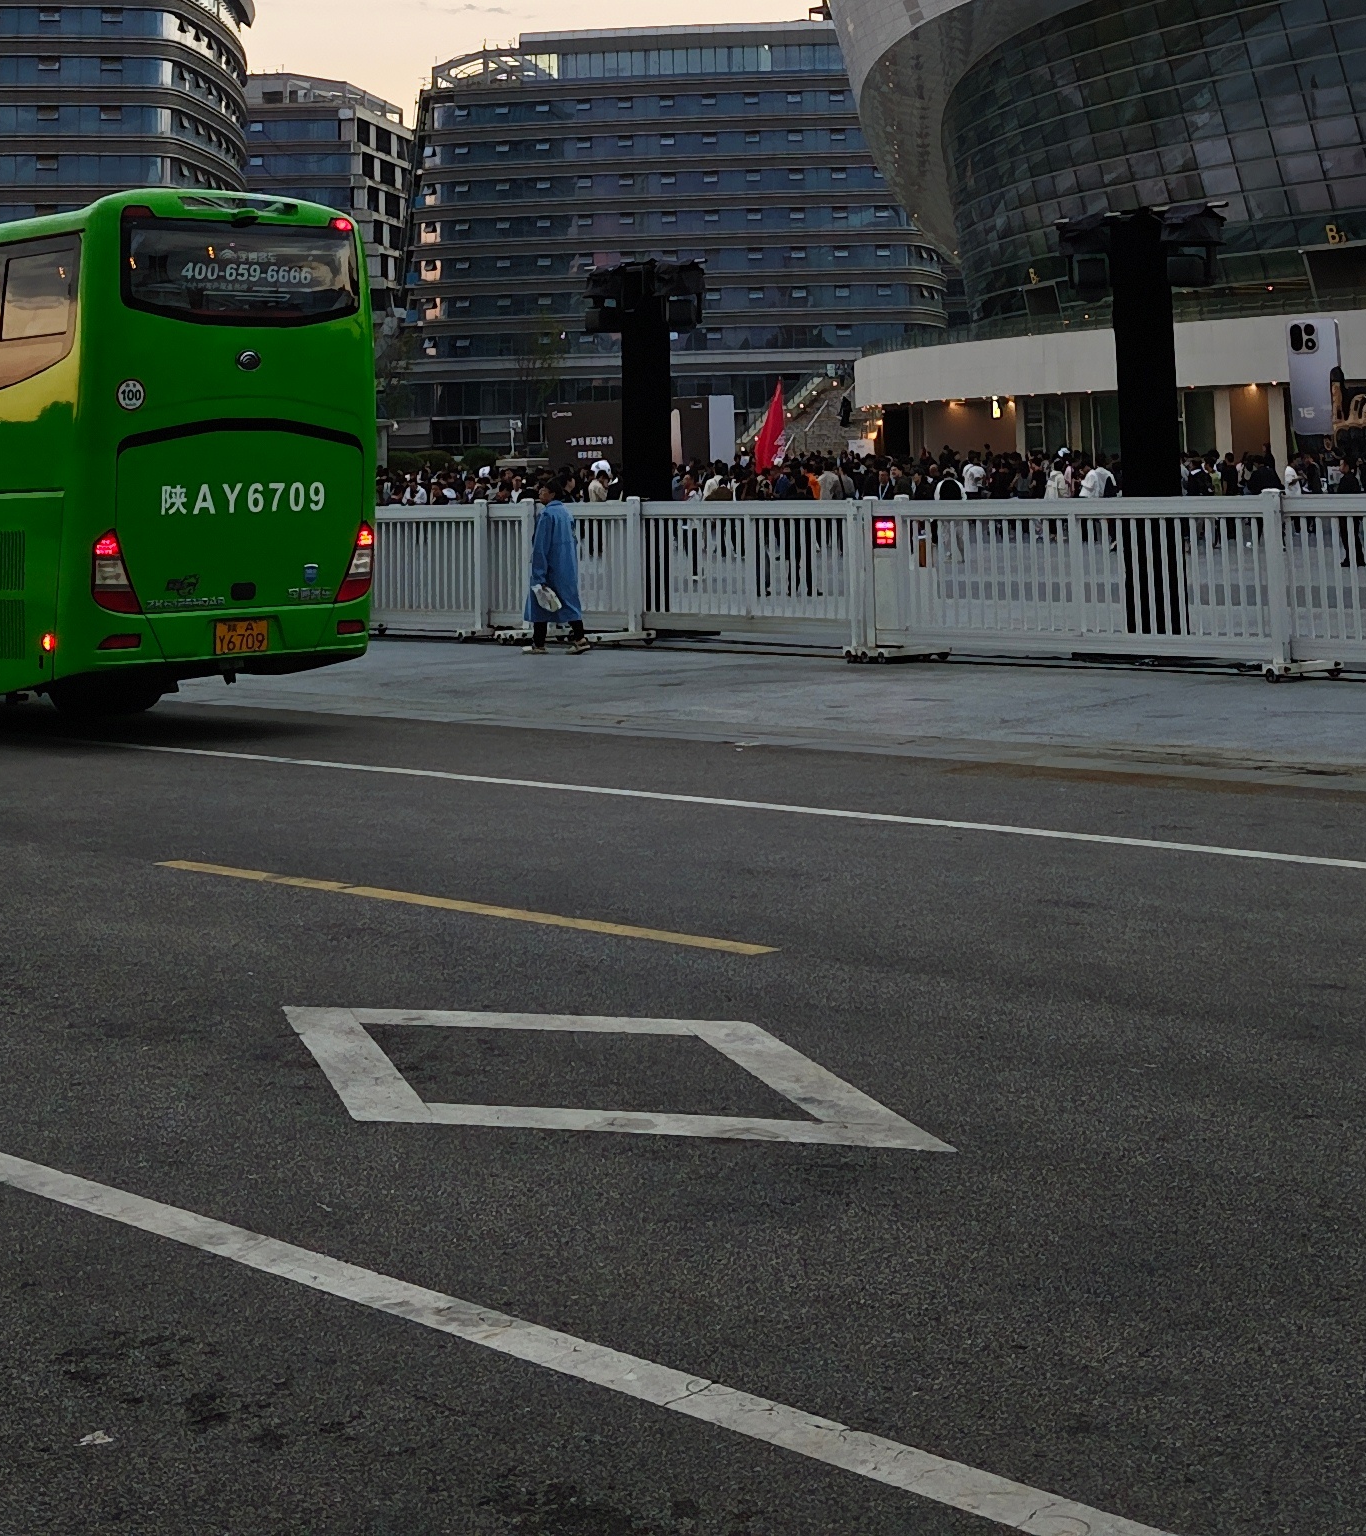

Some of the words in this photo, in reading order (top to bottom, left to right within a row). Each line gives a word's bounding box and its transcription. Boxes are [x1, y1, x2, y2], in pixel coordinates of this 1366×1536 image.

[181, 262, 312, 284] 400-659-6666
[121, 388, 142, 402] 100
[161, 481, 325, 515] 陕AY6709
[218, 632, 266, 652] Y6709
